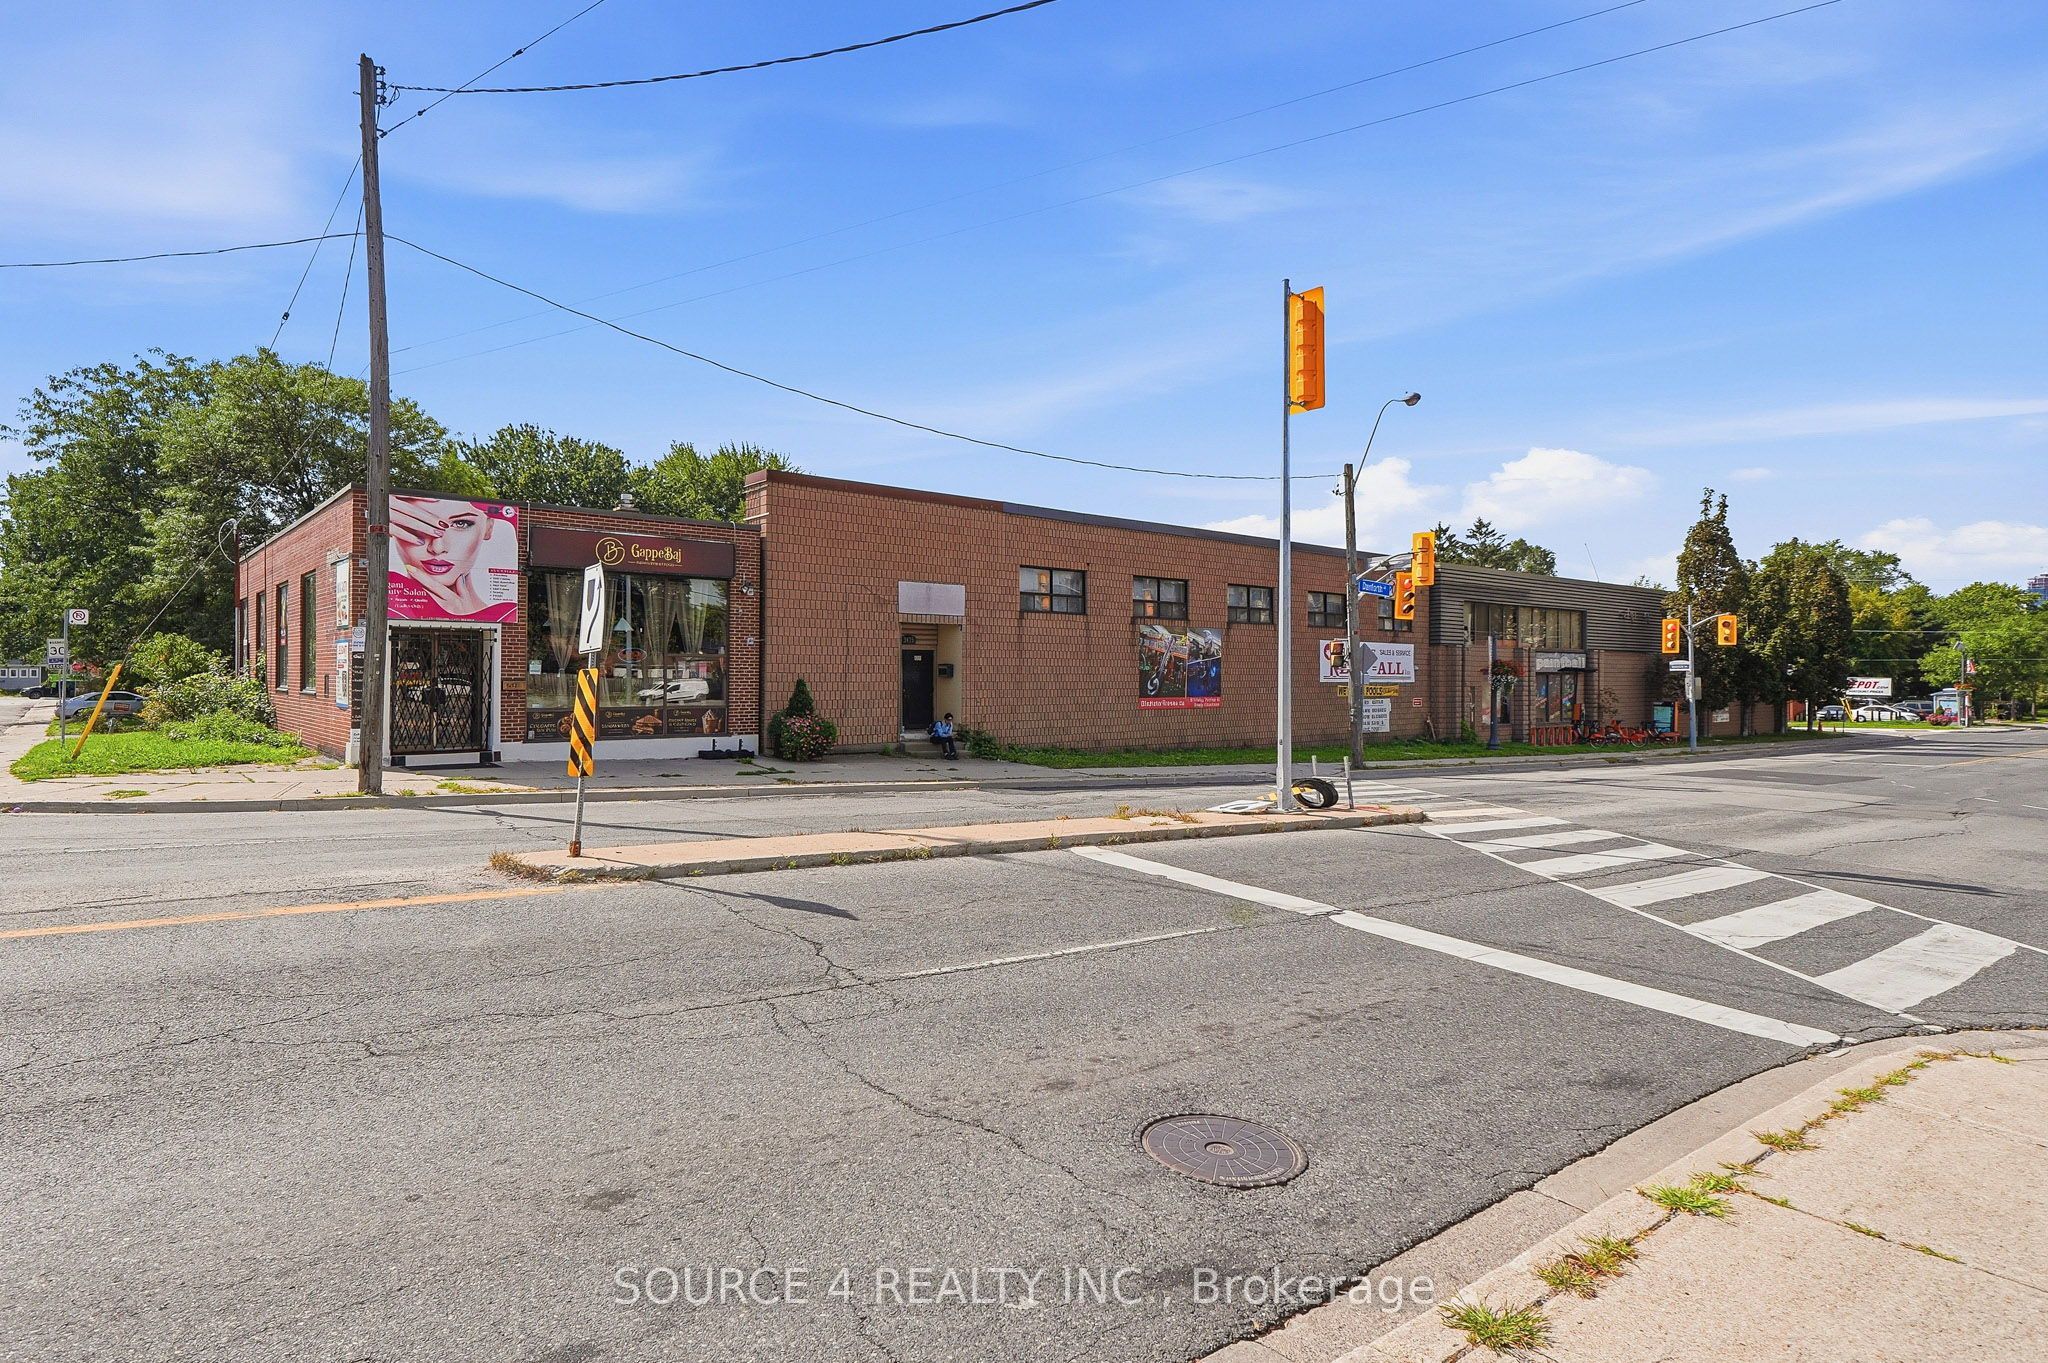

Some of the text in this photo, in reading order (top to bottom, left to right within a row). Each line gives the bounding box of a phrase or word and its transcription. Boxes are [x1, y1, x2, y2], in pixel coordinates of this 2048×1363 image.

[631, 543, 682, 564] GappeBaj
[403, 587, 427, 597] Salon
[1362, 581, 1383, 593] Danforth
[1338, 686, 1347, 695] WE
[1365, 686, 1383, 696] POOLS
